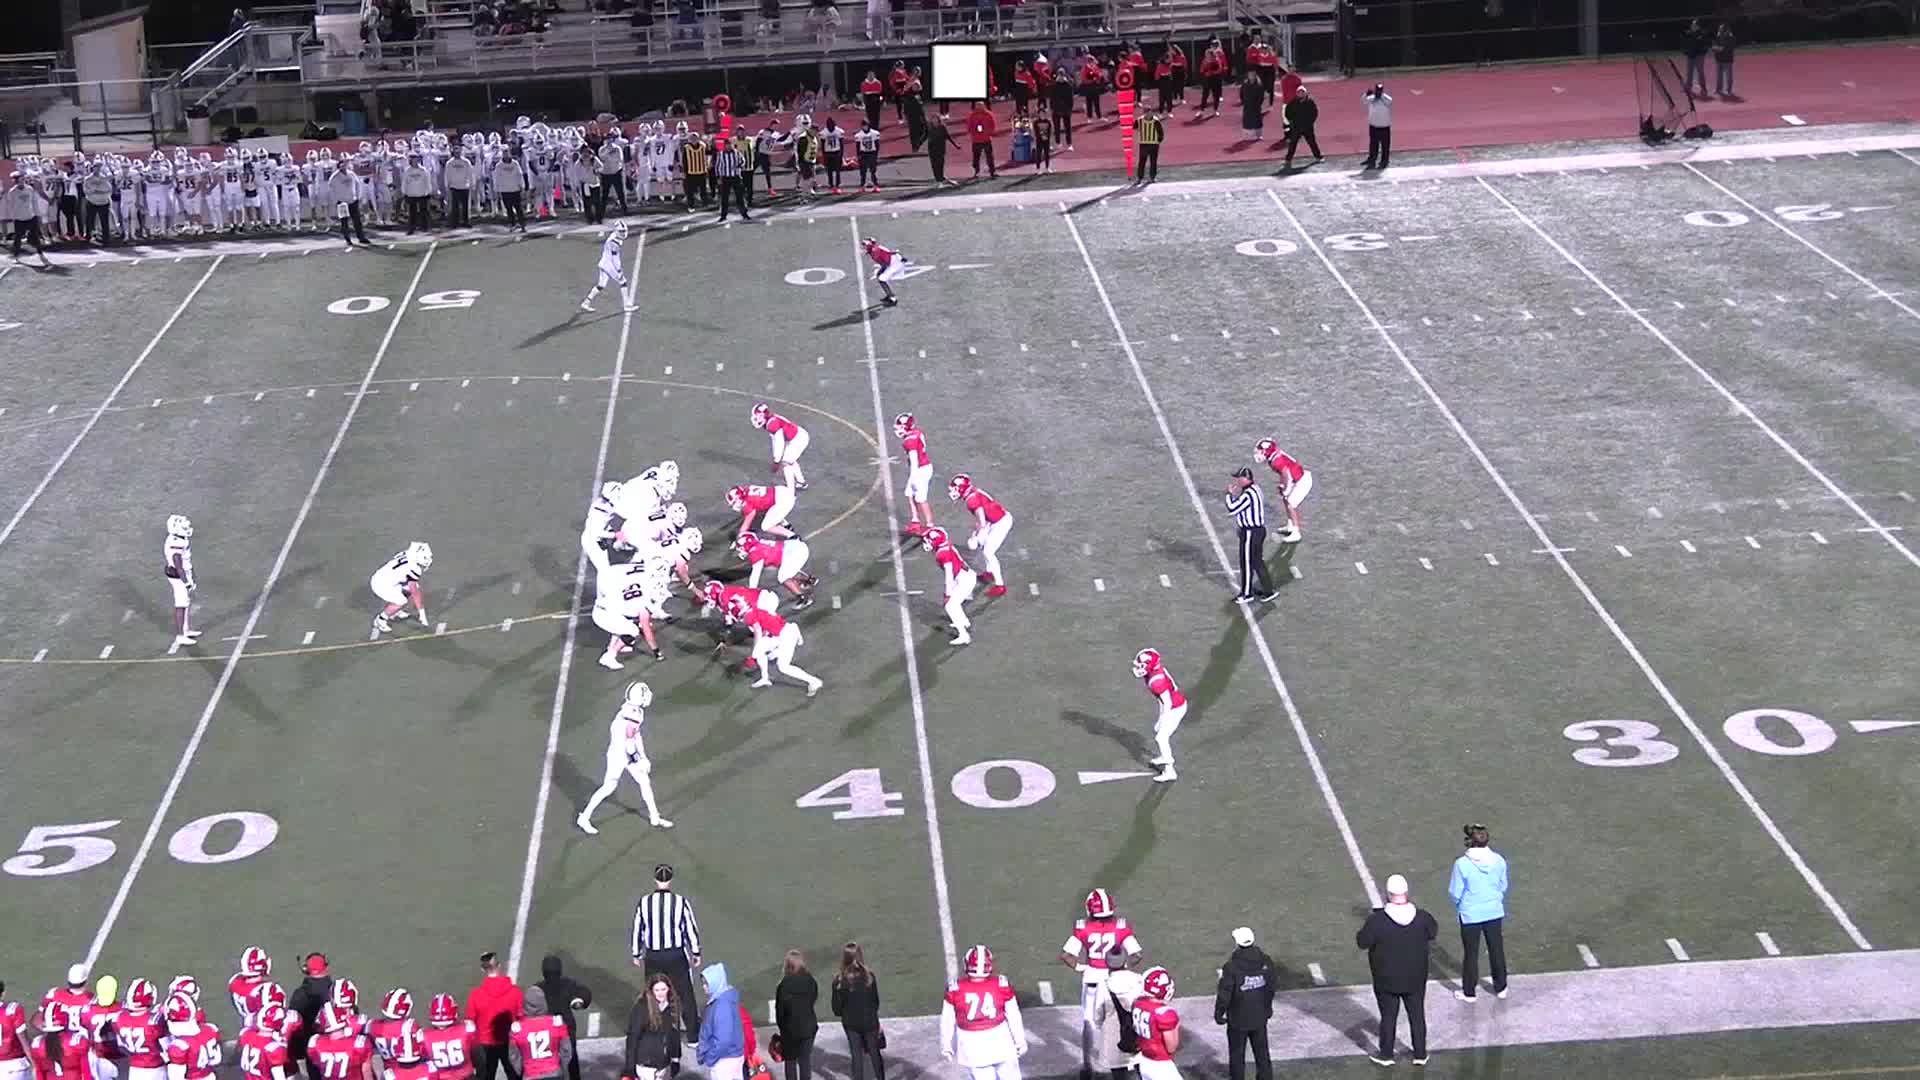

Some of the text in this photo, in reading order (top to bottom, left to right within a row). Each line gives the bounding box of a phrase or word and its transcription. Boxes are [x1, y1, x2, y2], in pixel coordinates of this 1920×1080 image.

[964, 992, 997, 1020] 74
[118, 1027, 149, 1054] 32
[196, 1038, 221, 1068] 45
[430, 1039, 464, 1068] 56
[526, 1031, 551, 1059] 12
[319, 1051, 350, 1079] 77
